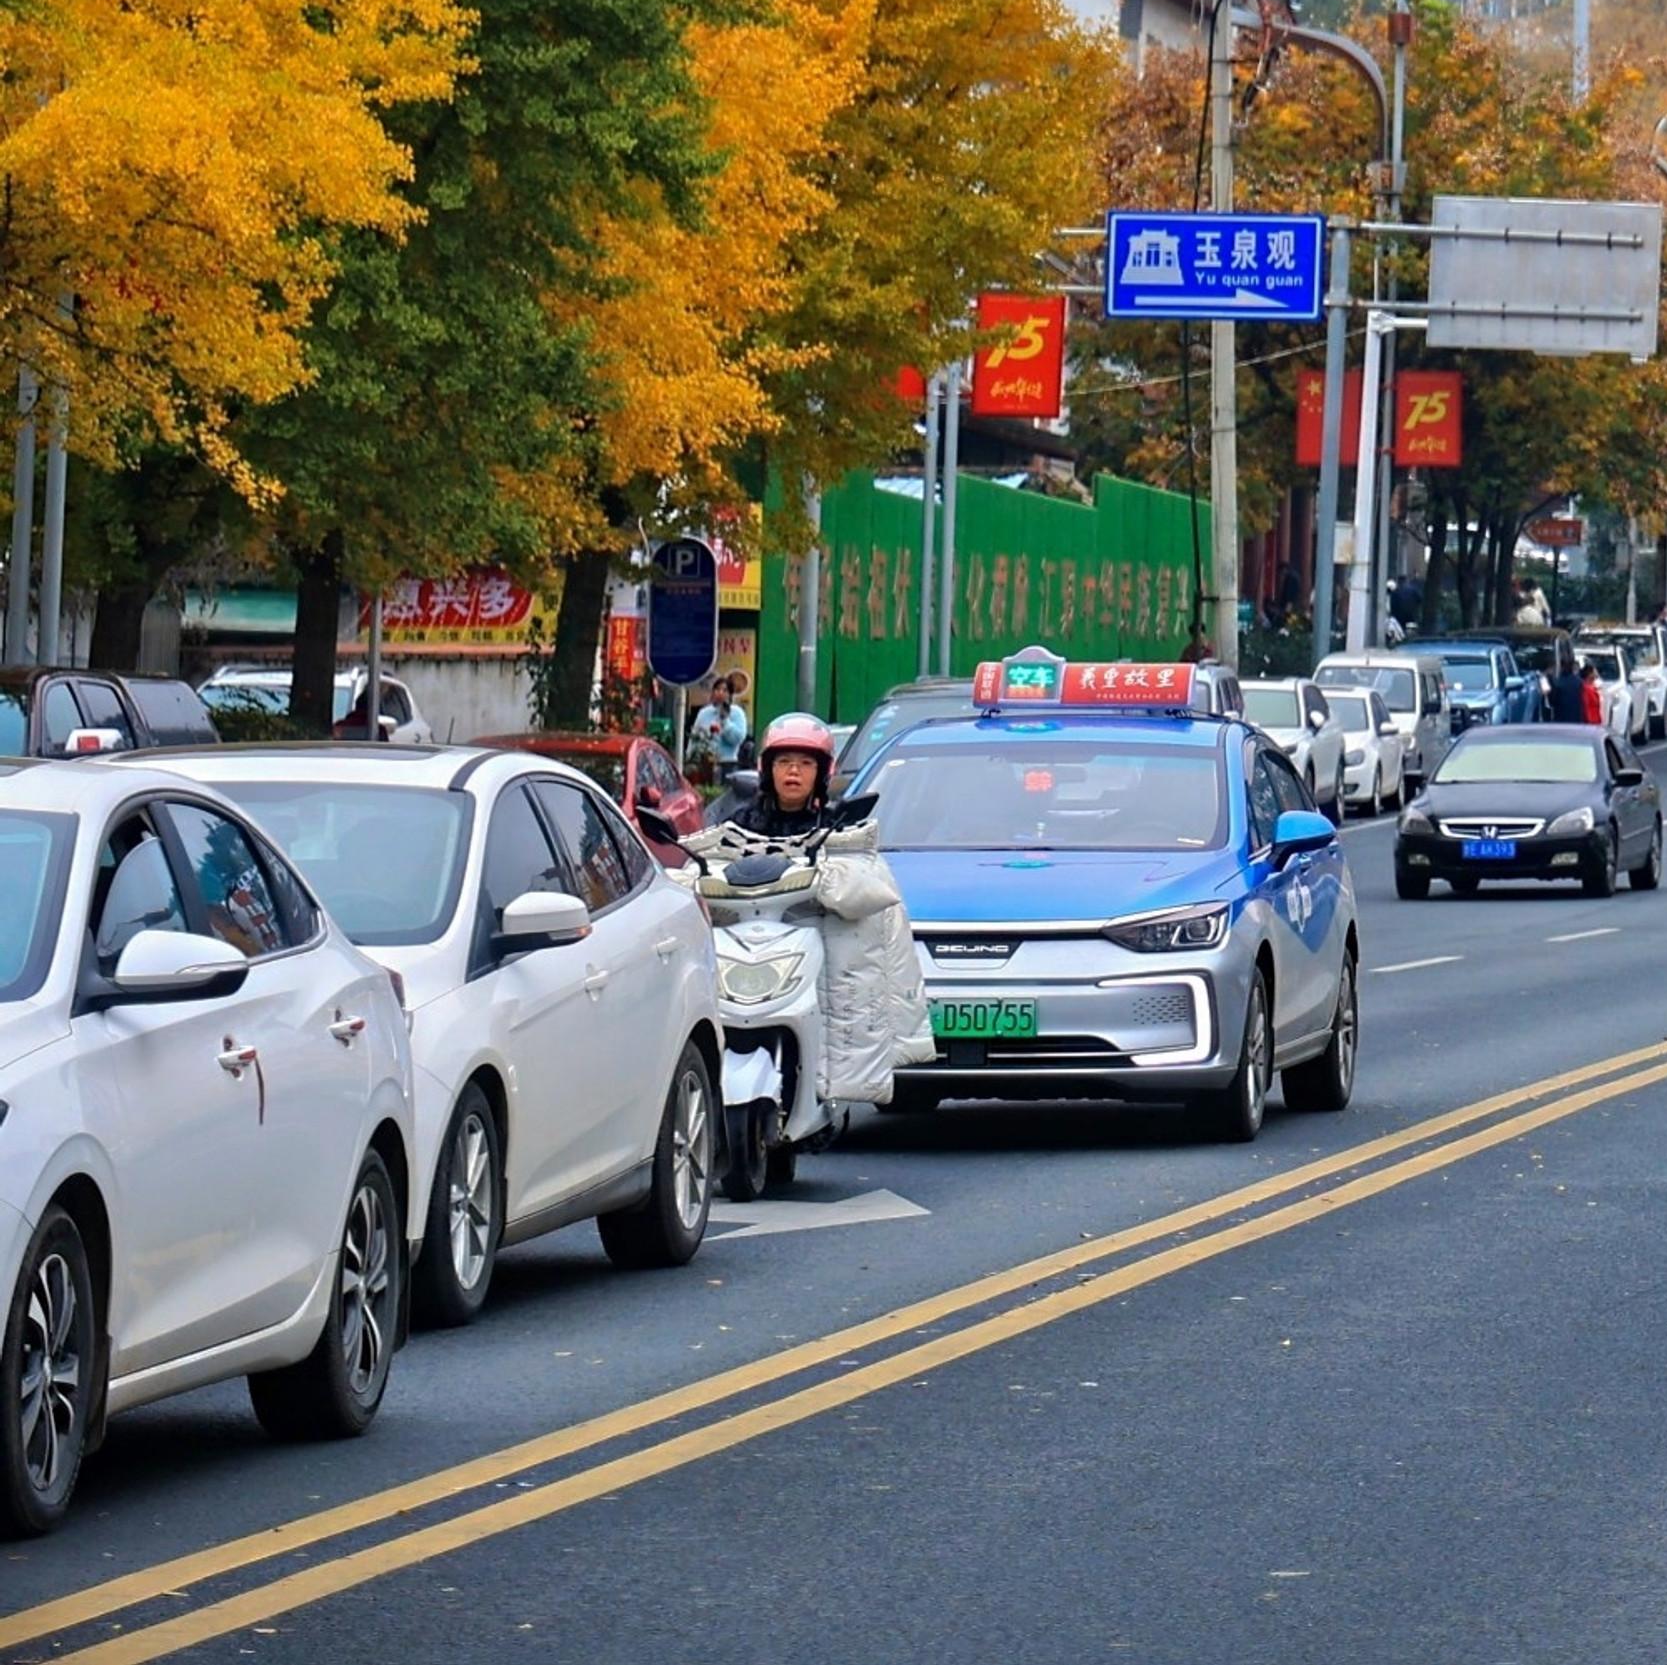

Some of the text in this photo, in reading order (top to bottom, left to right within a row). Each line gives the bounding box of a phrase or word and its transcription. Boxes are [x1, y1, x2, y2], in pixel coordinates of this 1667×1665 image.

[1194, 229, 1296, 270] 玉泉观
[1195, 271, 1303, 290] Yu quan guan
[1403, 392, 1451, 430] 75
[675, 549, 695, 575] P
[1008, 666, 1054, 689] 空车
[943, 1003, 1033, 1032] D50755
